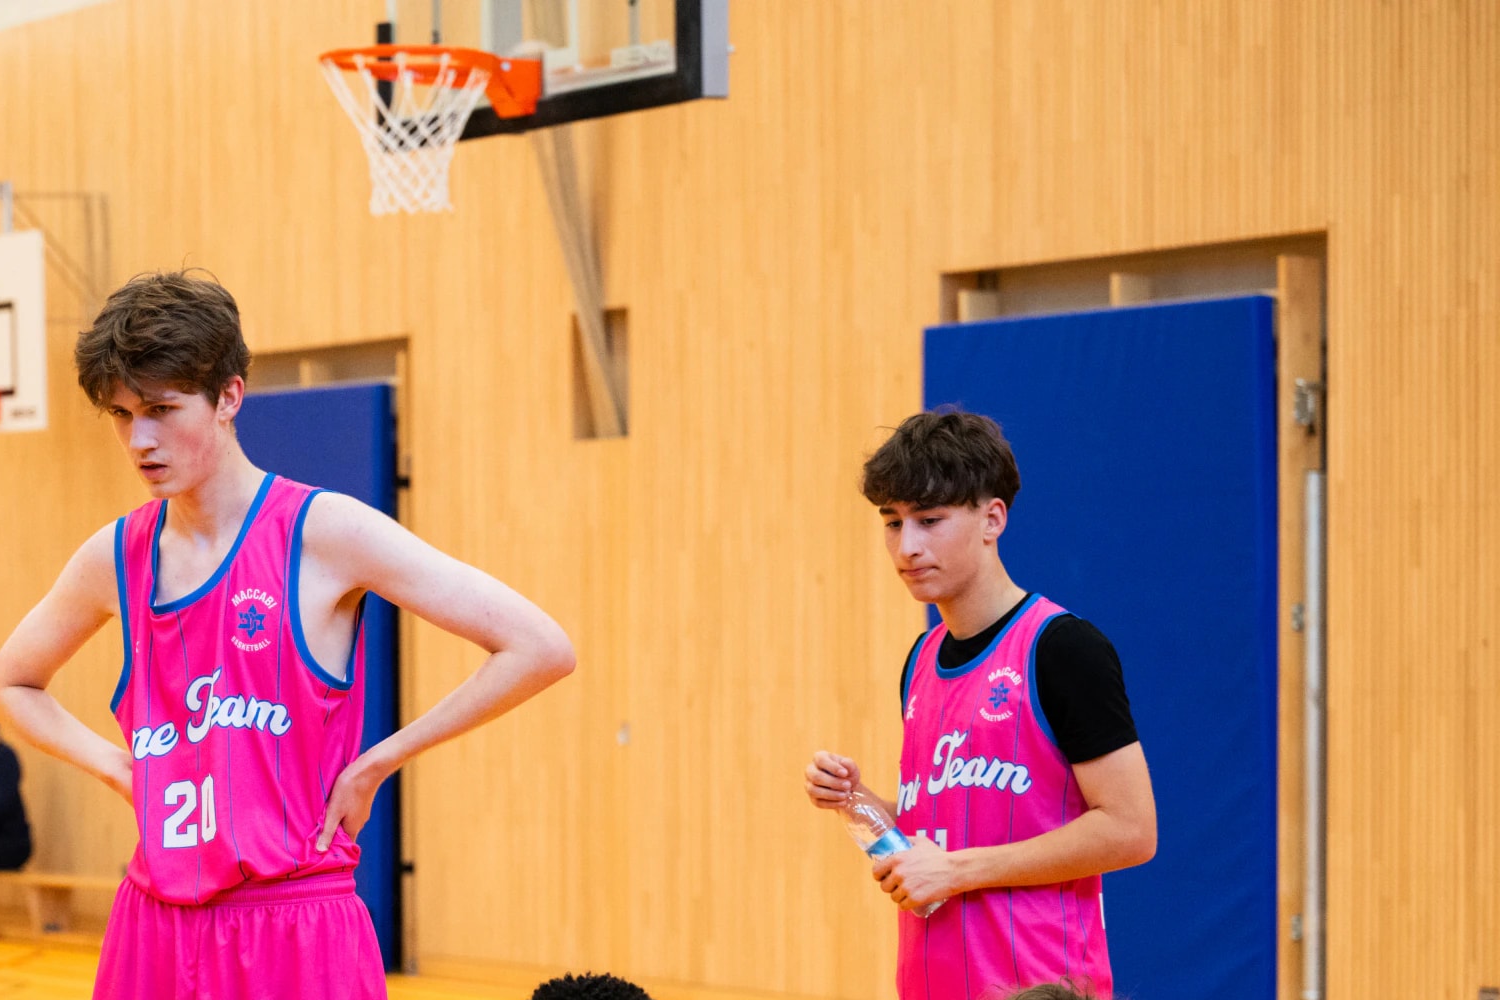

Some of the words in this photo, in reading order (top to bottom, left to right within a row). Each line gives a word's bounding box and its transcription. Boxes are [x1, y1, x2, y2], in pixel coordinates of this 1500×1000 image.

[231, 588, 278, 609] MACCABI
[231, 635, 271, 652] BASKETBALL
[132, 720, 180, 760] ne
[185, 666, 292, 744] Team
[927, 728, 1032, 796] Team
[162, 773, 217, 849] 20
